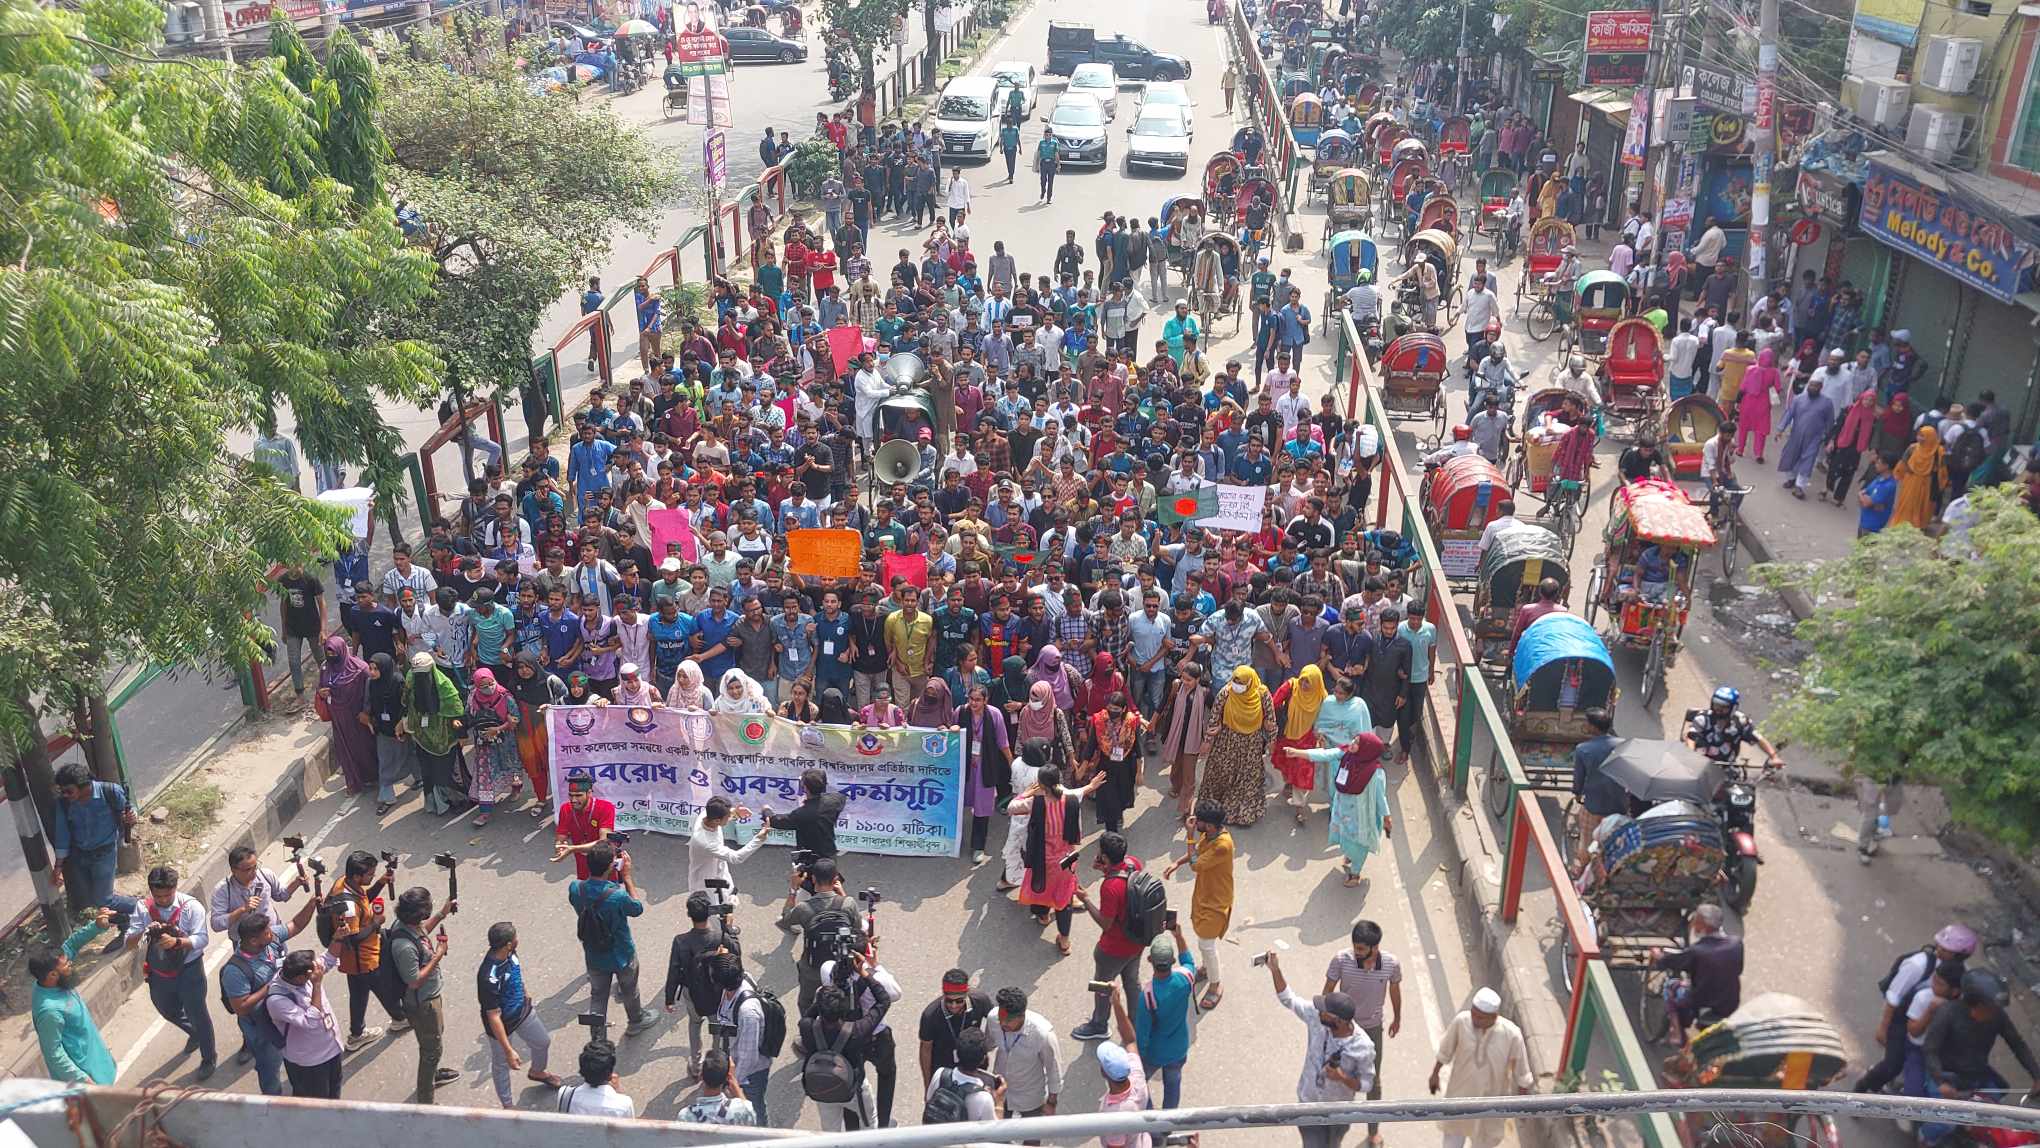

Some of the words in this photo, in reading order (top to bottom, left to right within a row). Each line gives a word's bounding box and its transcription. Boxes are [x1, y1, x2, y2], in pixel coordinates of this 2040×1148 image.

[1591, 18, 1617, 36] কাজী
[1620, 19, 1649, 36] অফিস
[1699, 69, 1731, 92] কলেজ
[1887, 210, 1950, 261] Melody
[1951, 240, 1964, 263] &
[1967, 249, 2000, 283] Co.
[561, 744, 581, 757] সাত
[584, 742, 627, 753] কলেজের
[665, 744, 691, 757] একটি
[778, 755, 816, 769] পাবলিক
[819, 758, 874, 773] বিশ্ববিদ্যালয়
[877, 761, 914, 774] প্রতিষ্ঠার
[918, 763, 952, 776] দাবিতে
[687, 768, 710, 787] ও
[719, 771, 807, 801] অবস্থা
[837, 778, 946, 811] কর্মসূচি
[656, 800, 705, 816] অক্টোব
[856, 818, 895, 833] ১১:০০
